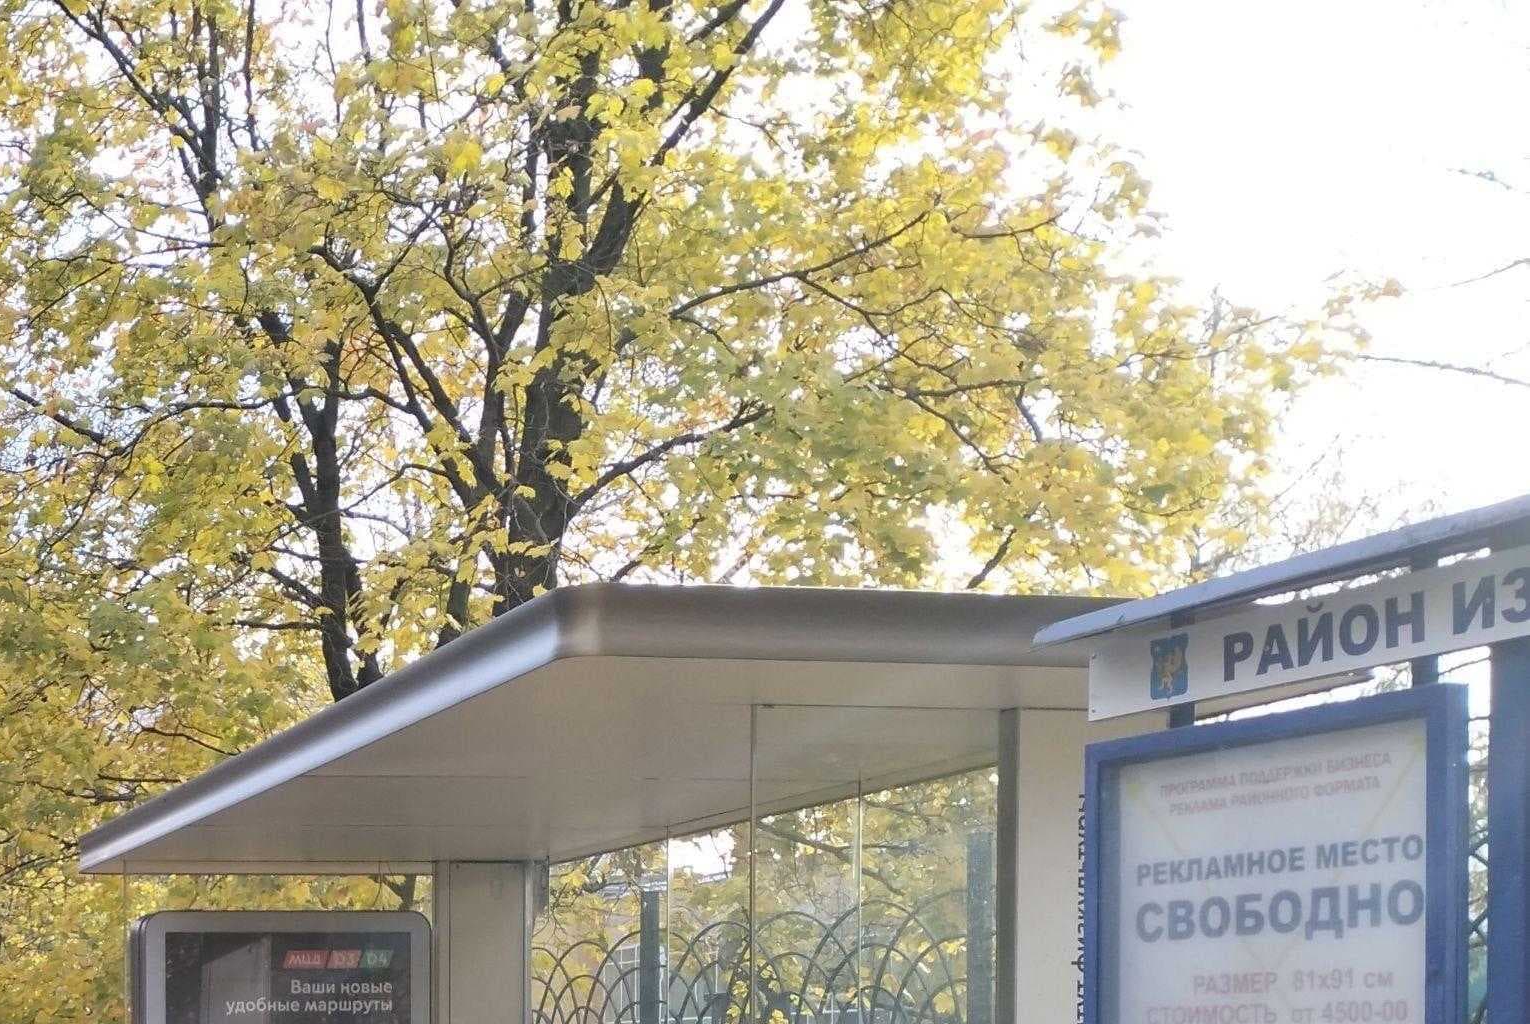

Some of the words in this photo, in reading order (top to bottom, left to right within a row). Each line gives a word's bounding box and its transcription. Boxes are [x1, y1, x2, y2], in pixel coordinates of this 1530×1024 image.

[1223, 591, 1426, 682] РАЙОН
[1160, 774, 1236, 798] ПРОГРАММА
[1239, 762, 1324, 785] ПОДДЕРЖКИ
[1327, 752, 1392, 772] БИЗНЕСА
[1169, 797, 1226, 816] РЕКЛАМА
[1230, 786, 1310, 807] РАЙОННОГО
[1314, 775, 1381, 797] ФОРМАТА
[1136, 847, 1306, 886] РЕКЛАМНОЕ
[1315, 834, 1424, 870] МЕСТО
[1135, 878, 1425, 943] СВОБОДНО
[290, 979, 336, 994] Ваши
[340, 981, 393, 994] новые
[1192, 971, 1278, 995] РАЗМЕР
[1362, 971, 1395, 989] см
[225, 997, 301, 1016] удобные
[304, 1000, 393, 1015] маршруты
[1291, 1008, 1317, 1024] от
[1321, 1000, 1409, 1024] 4500-00
